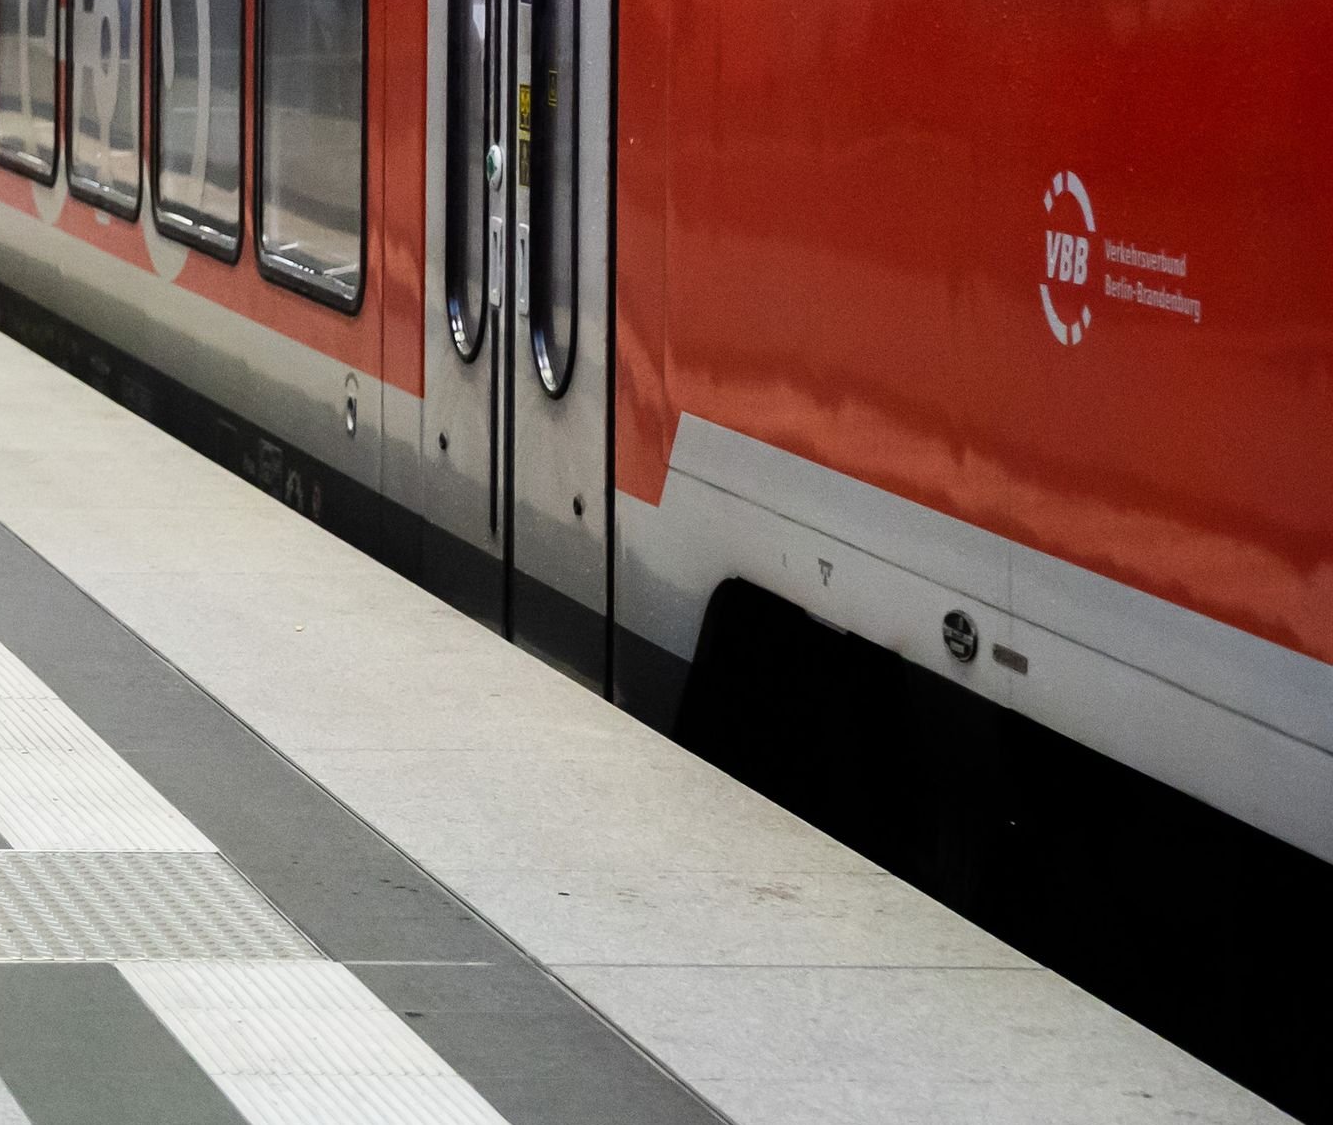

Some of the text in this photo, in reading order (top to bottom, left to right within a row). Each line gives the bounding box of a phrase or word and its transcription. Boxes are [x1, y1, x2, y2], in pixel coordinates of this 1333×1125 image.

[1046, 230, 1089, 285] VBB
[1105, 239, 1187, 277] Verkehrsverbund
[1105, 274, 1201, 323] Berlin-Brandenburg
